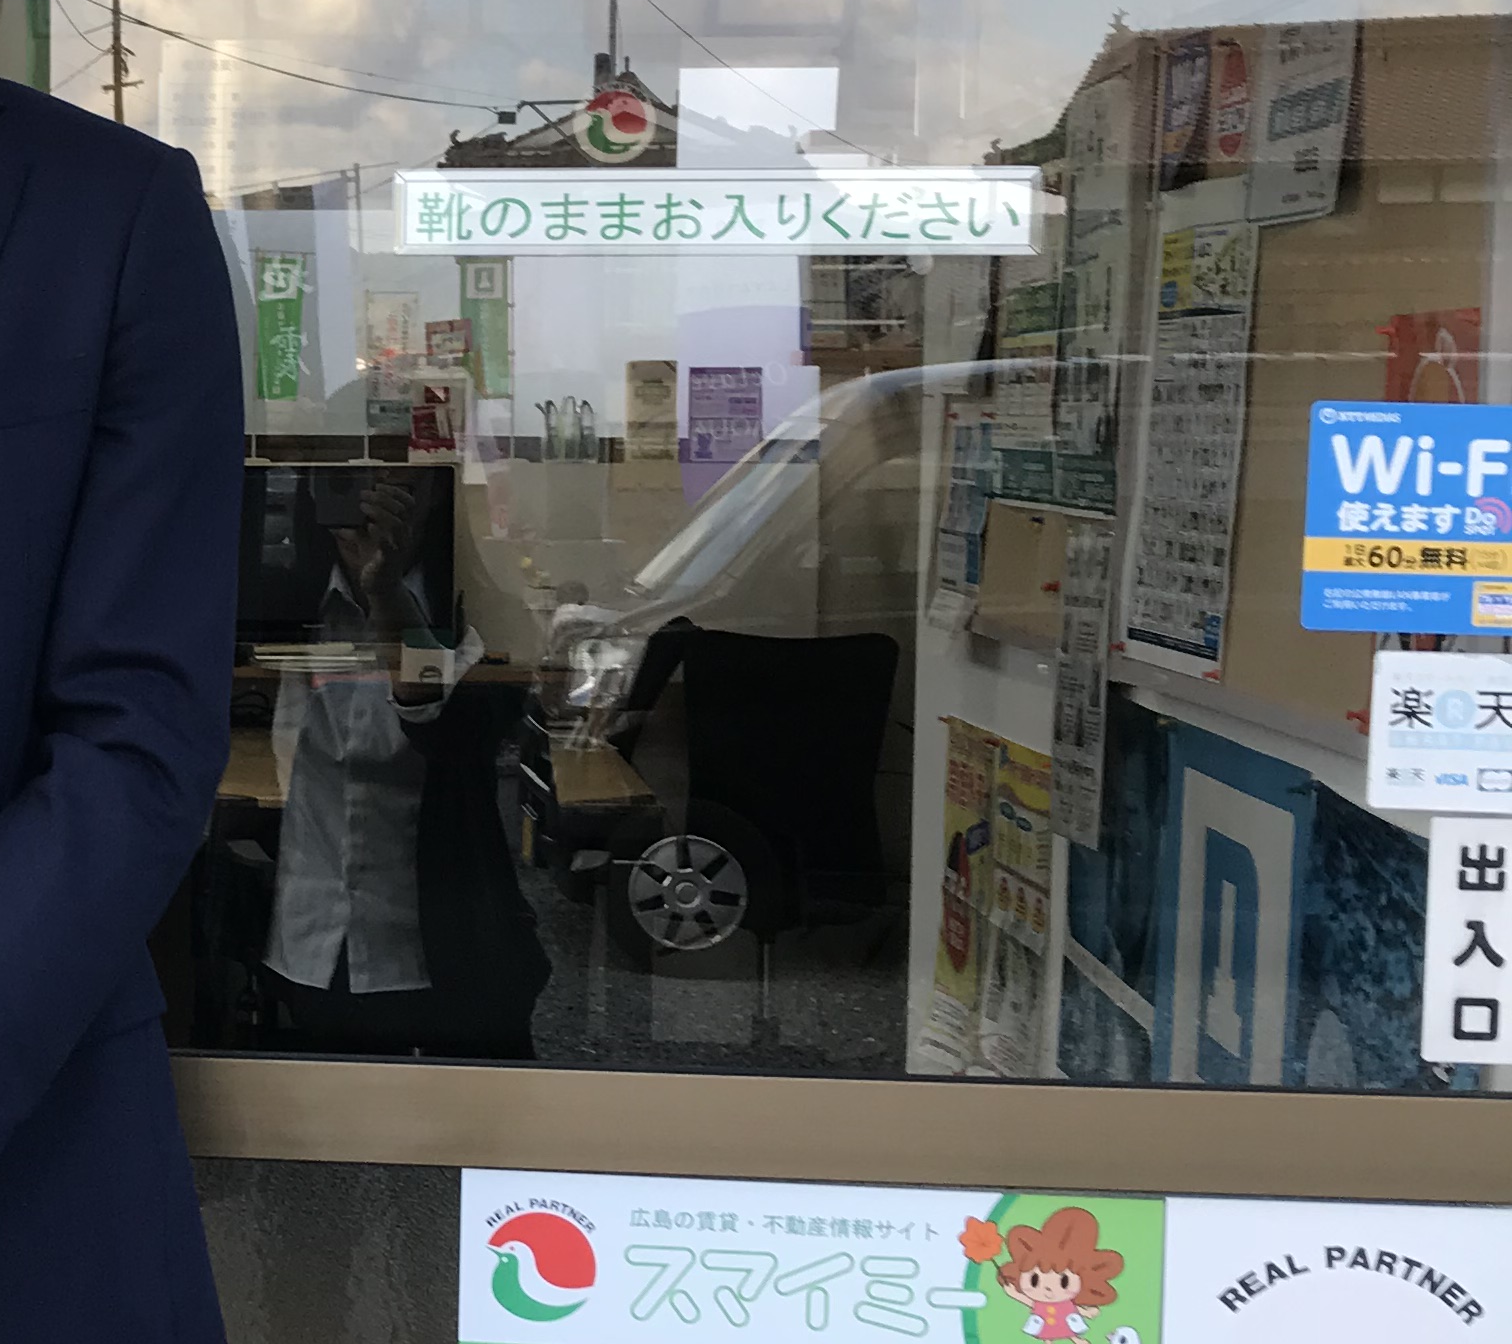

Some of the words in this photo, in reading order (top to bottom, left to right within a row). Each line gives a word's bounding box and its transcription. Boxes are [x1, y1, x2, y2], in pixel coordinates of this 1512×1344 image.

[416, 189, 1022, 243] 靴のままお入りください
[1331, 433, 1512, 498] Wi-F
[1337, 500, 1462, 534] 使えます
[1453, 843, 1506, 1041] 出入口
[484, 1199, 525, 1229] REAL
[528, 1197, 597, 1234] PARTNER
[629, 1208, 940, 1242] 広島の賃貸・不動産情報サイト
[624, 1244, 988, 1338] スマイミー
[1216, 1254, 1310, 1314] REAL
[1324, 1244, 1488, 1327] PARTNER
